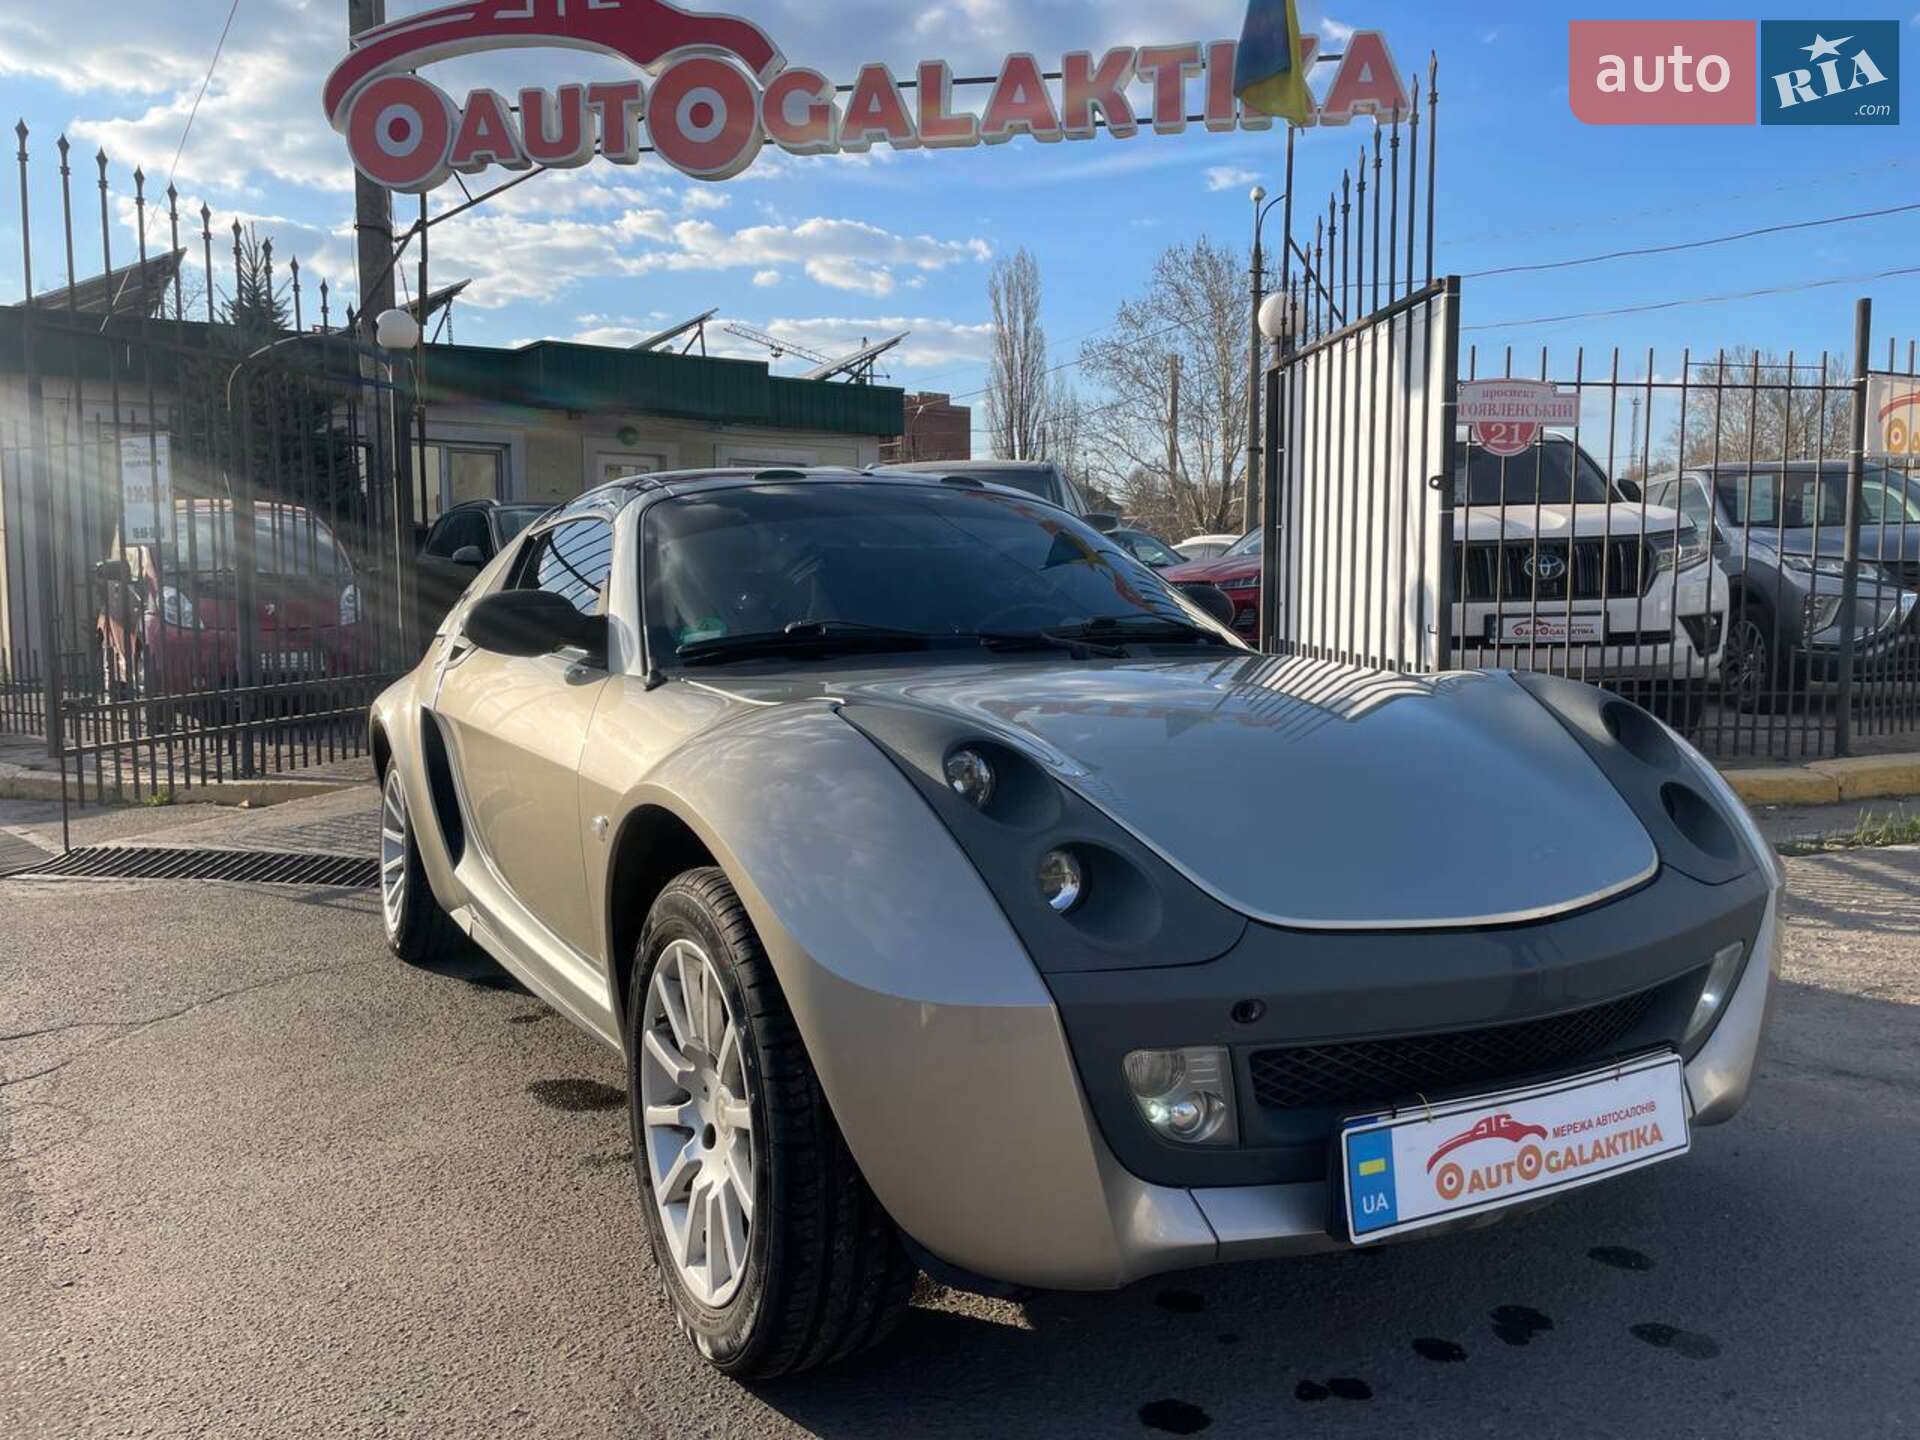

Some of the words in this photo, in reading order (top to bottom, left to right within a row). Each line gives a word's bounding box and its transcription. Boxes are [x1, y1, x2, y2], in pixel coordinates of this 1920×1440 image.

[1482, 387, 1537, 400] проспект
[1490, 422, 1522, 444] 21
[1552, 1117, 1594, 1139] МЕРЕЖА
[1595, 1100, 1657, 1127] АВТОСАЛОНІВ
[1362, 1191, 1390, 1214] UA
